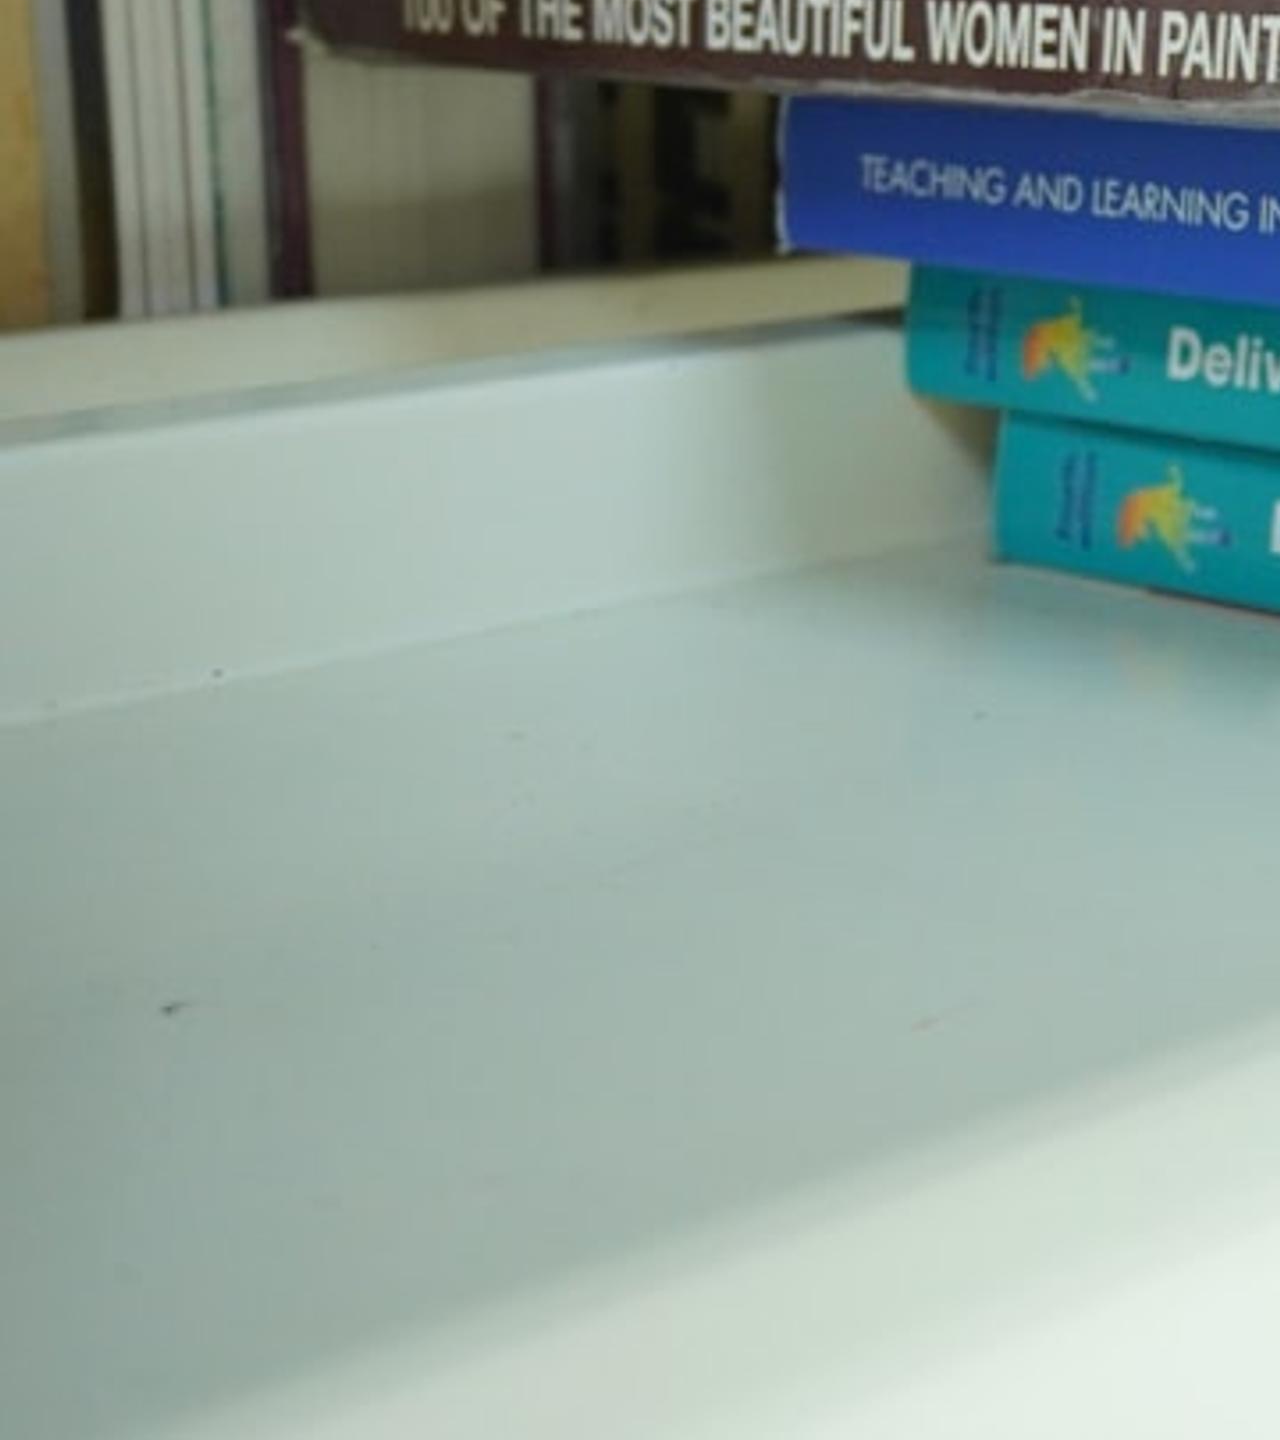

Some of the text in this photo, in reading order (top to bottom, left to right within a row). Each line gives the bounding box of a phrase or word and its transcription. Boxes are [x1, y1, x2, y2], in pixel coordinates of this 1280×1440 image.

[1102, 6, 1147, 76] IN
[860, 153, 1006, 206] TEACHING
[1013, 171, 1083, 213] AND
[1092, 178, 1250, 232] LEARNING
